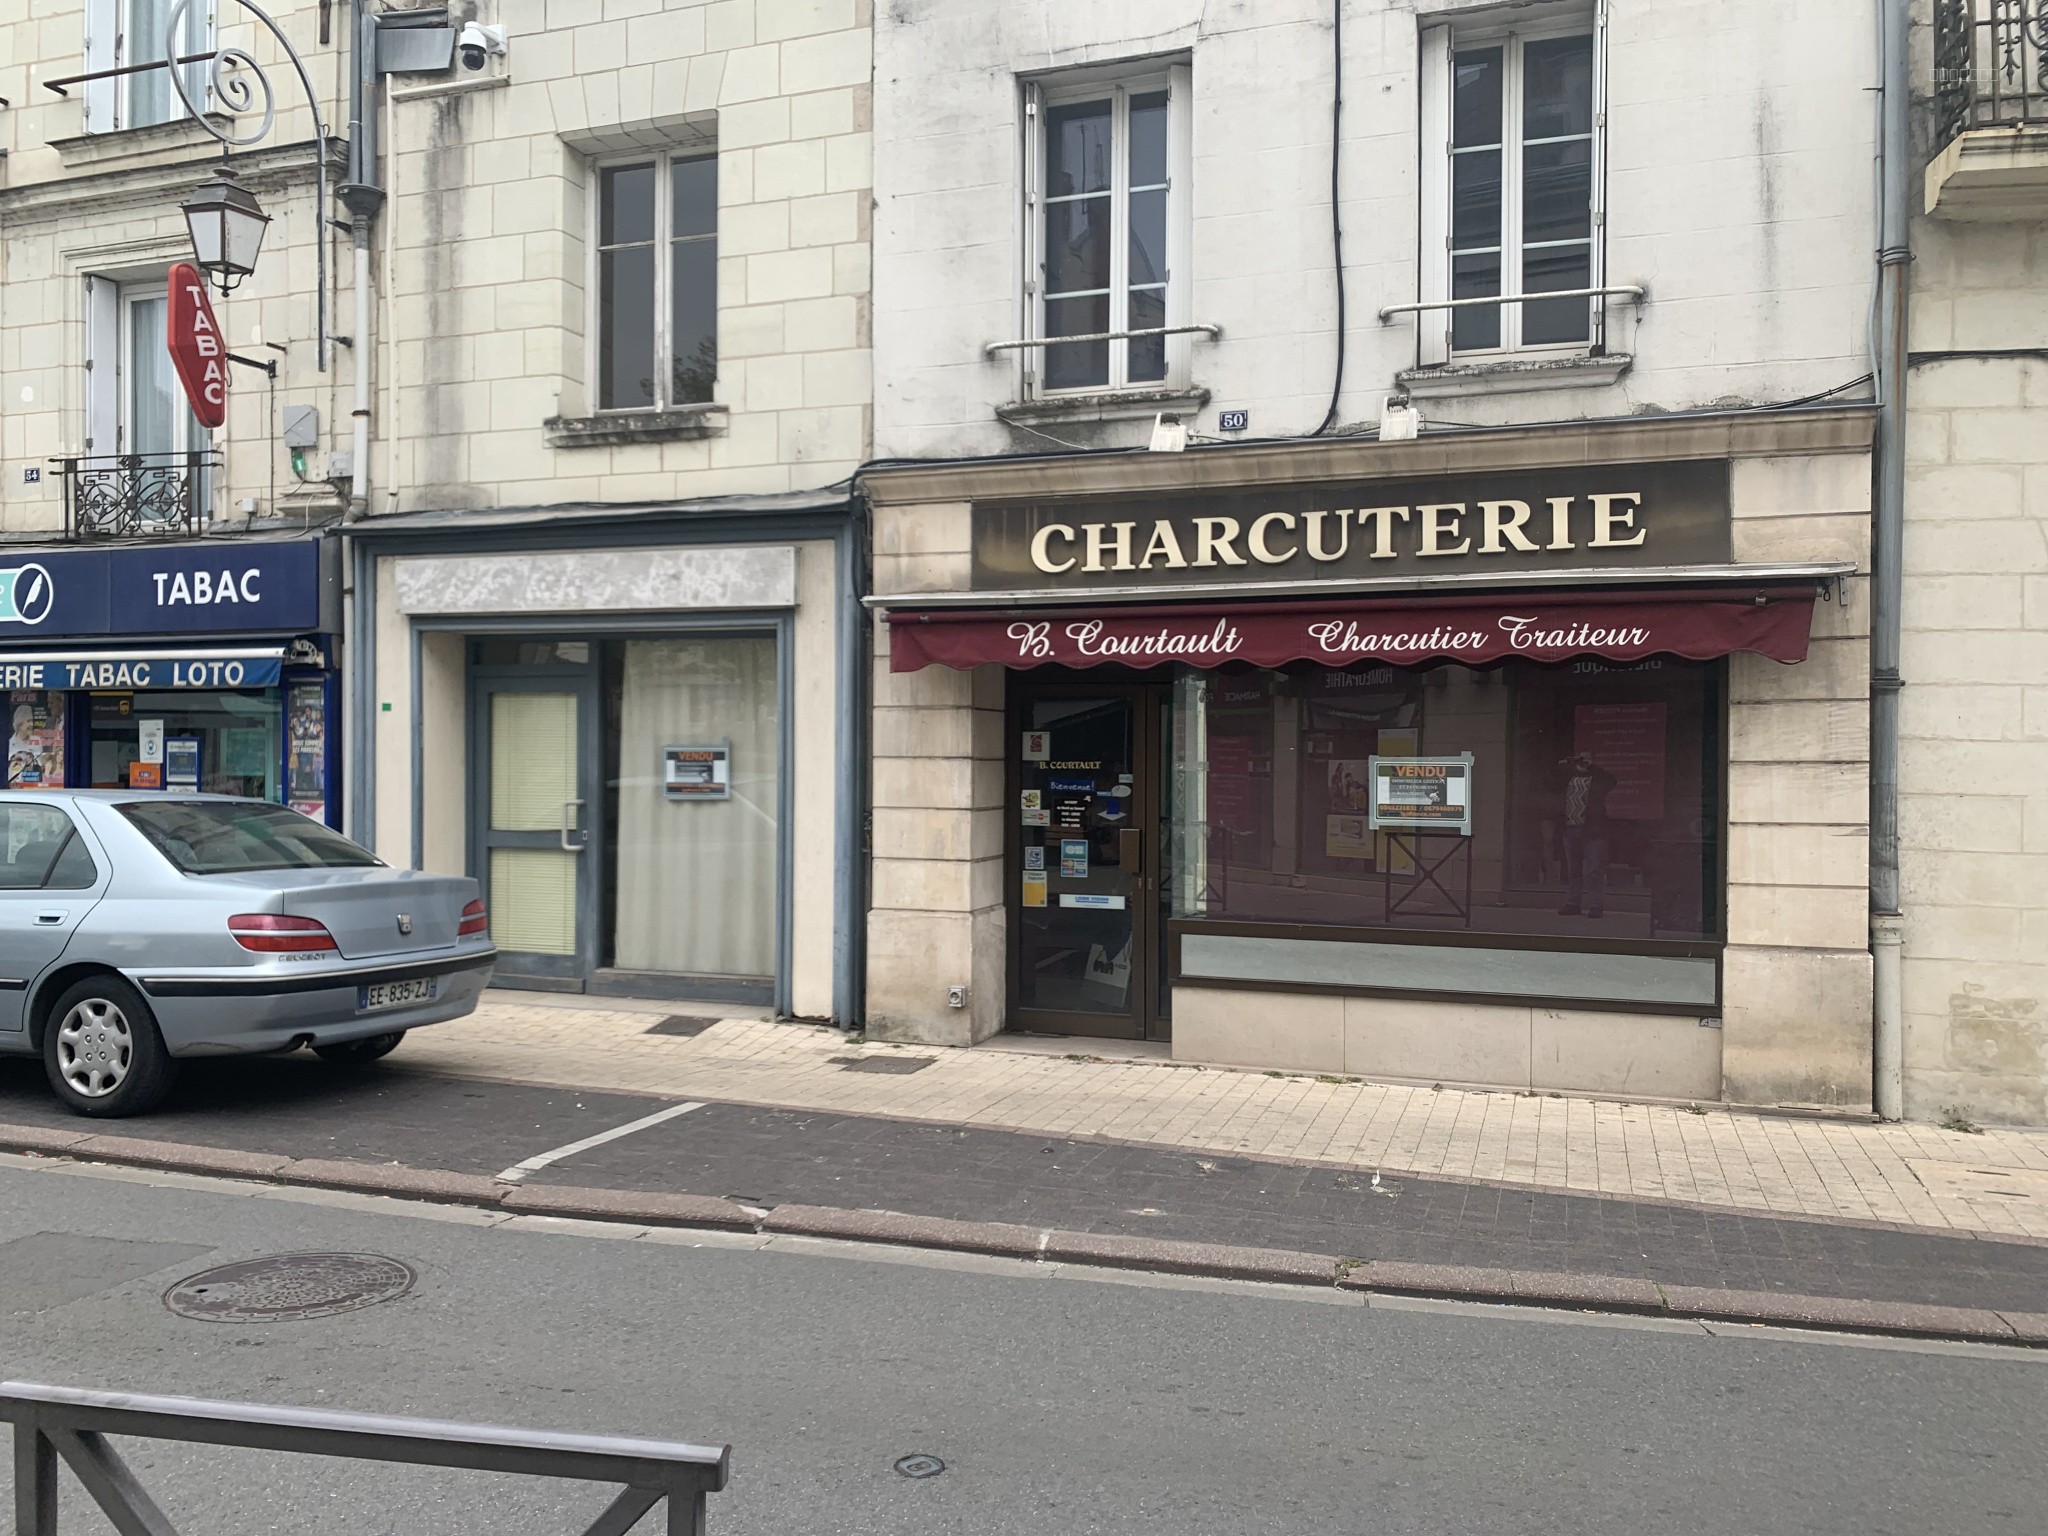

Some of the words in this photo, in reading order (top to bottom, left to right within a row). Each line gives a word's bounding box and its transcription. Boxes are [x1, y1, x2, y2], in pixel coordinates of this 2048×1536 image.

[185, 285, 223, 405] TABAC
[1223, 411, 1244, 428] 50
[26, 470, 38, 481] 54
[1030, 492, 1647, 574] CHARCUTERIE
[152, 568, 260, 606] TABAC
[1006, 621, 1055, 658] B.
[1065, 617, 1243, 656] Courtault
[1308, 620, 1489, 652] Charcutier
[1497, 615, 1651, 649] Traiteur
[0, 664, 44, 689] RIE
[65, 663, 150, 687] TABAC
[173, 661, 244, 687] LOTO
[679, 752, 713, 761] VENDU
[1050, 761, 1101, 769] COURTAULT
[1396, 766, 1446, 777] VENDU
[1050, 780, 1095, 791] Bienvenue!
[278, 953, 327, 962] PEUGEOT
[368, 979, 429, 1006] EE-835-ZJ
